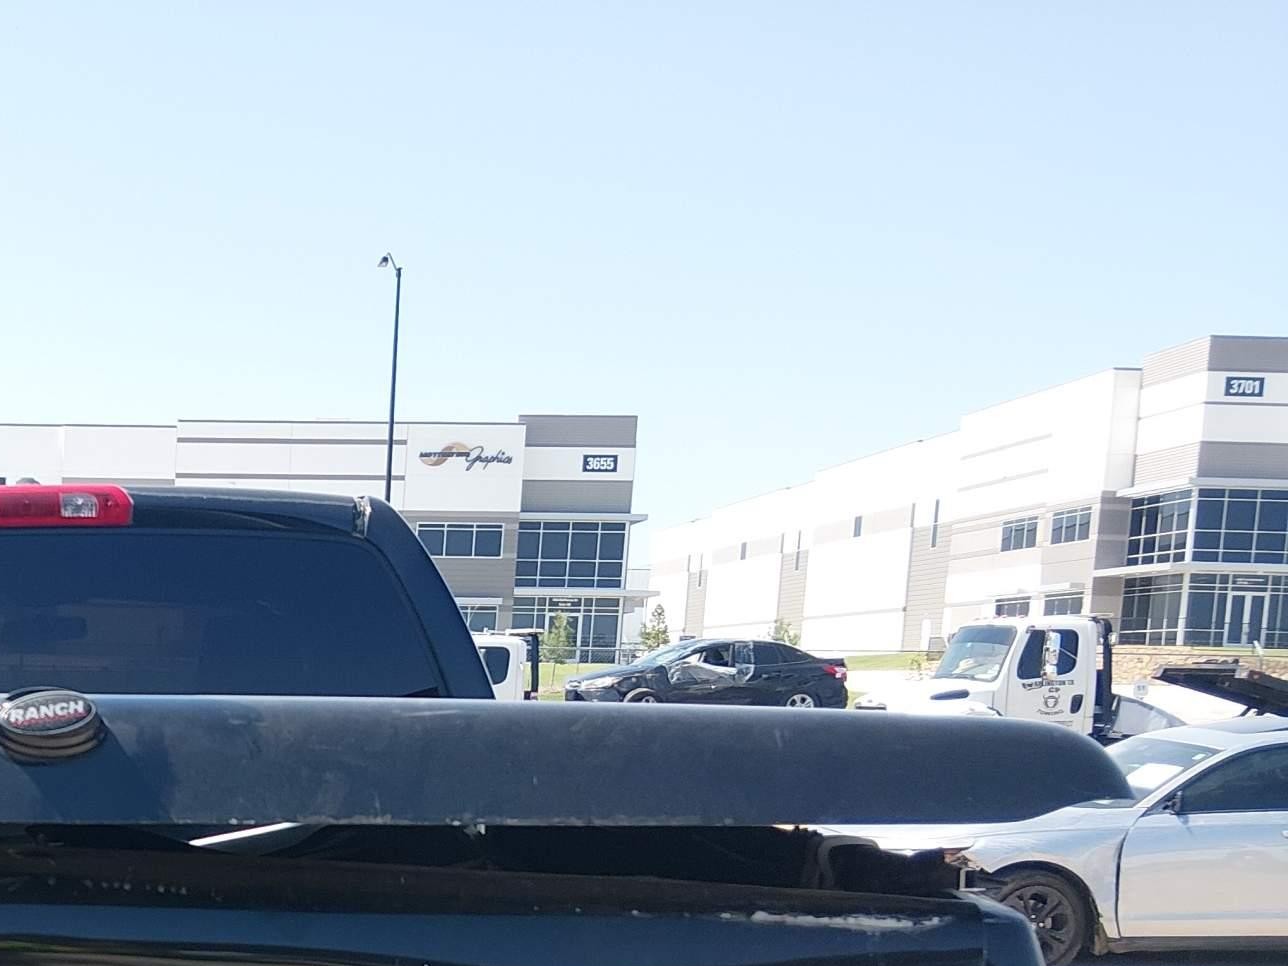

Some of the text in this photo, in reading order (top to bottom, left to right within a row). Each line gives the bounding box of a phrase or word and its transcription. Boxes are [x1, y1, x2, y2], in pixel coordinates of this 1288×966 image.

[1229, 379, 1261, 394] 3701
[585, 457, 615, 470] 3655
[9, 700, 85, 723] RANCH
